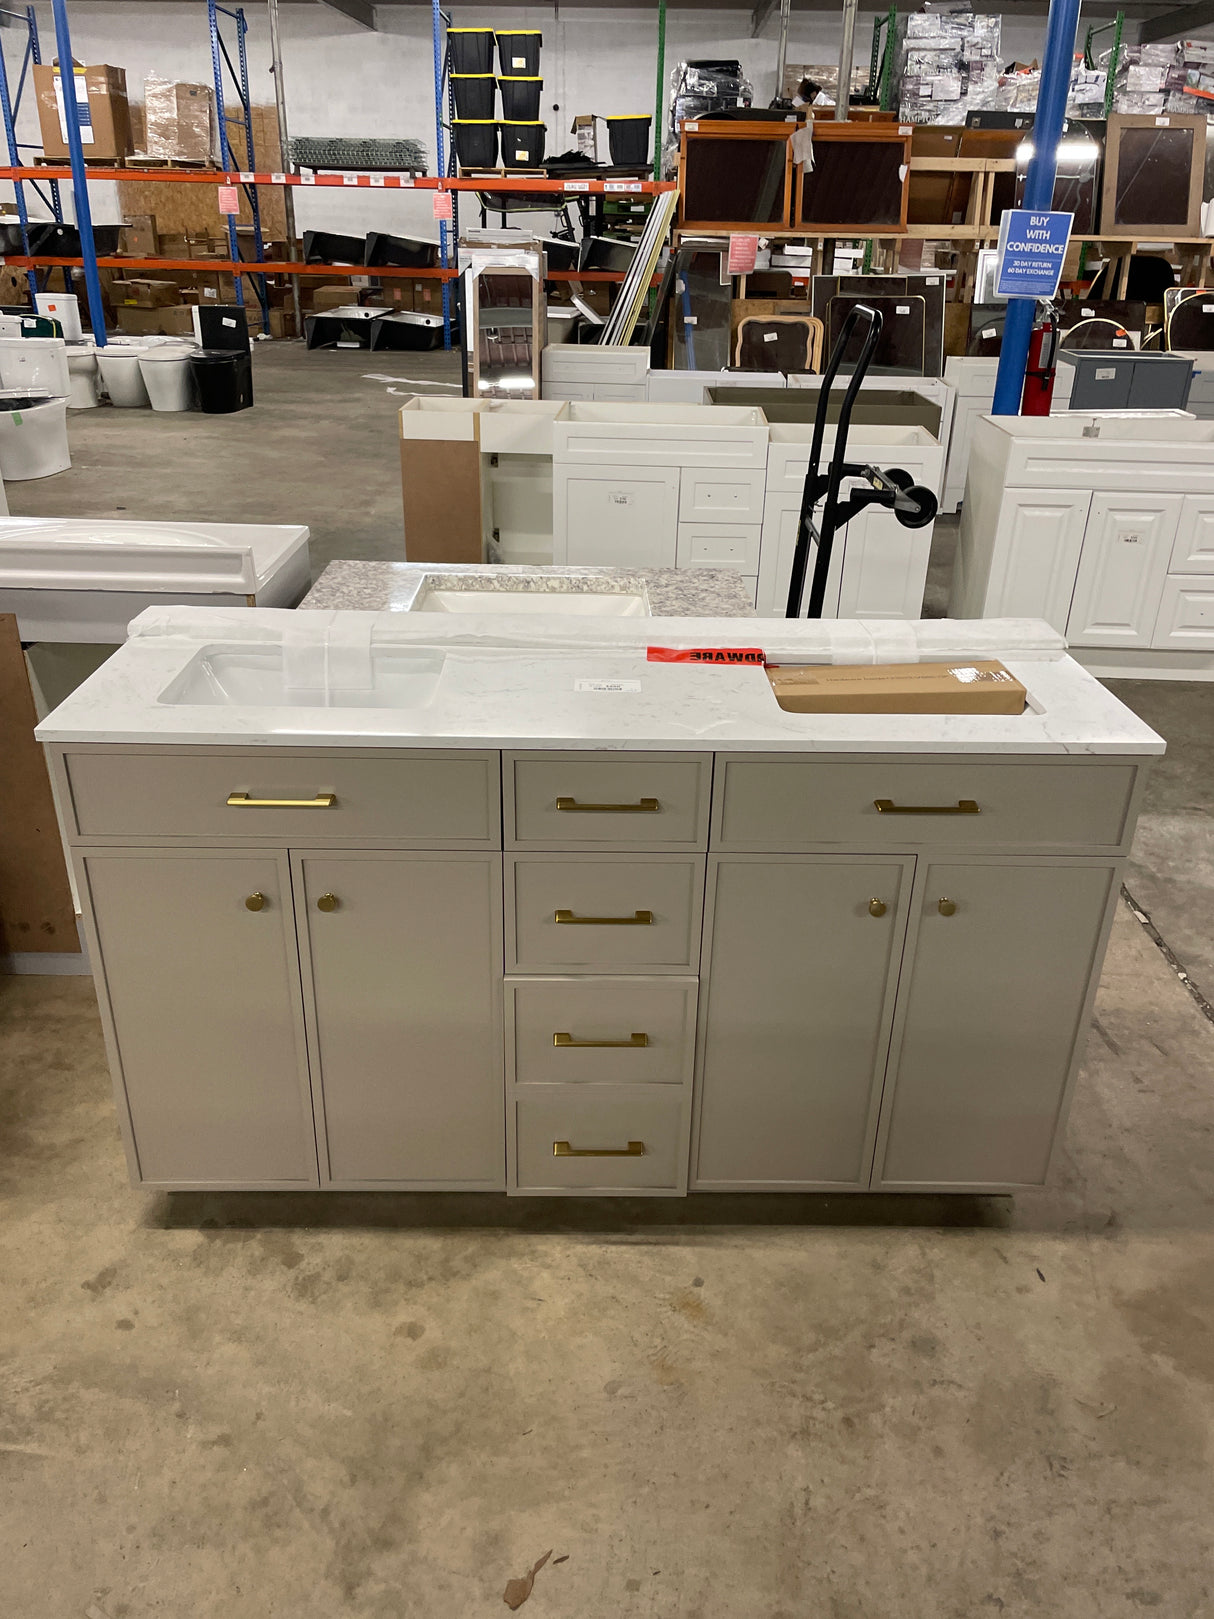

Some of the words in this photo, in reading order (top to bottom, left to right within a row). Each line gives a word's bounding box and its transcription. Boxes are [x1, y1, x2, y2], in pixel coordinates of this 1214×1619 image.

[1030, 216, 1049, 226] BUY
[1026, 229, 1050, 240] WITH
[1007, 241, 1064, 254] CONFIDENCE
